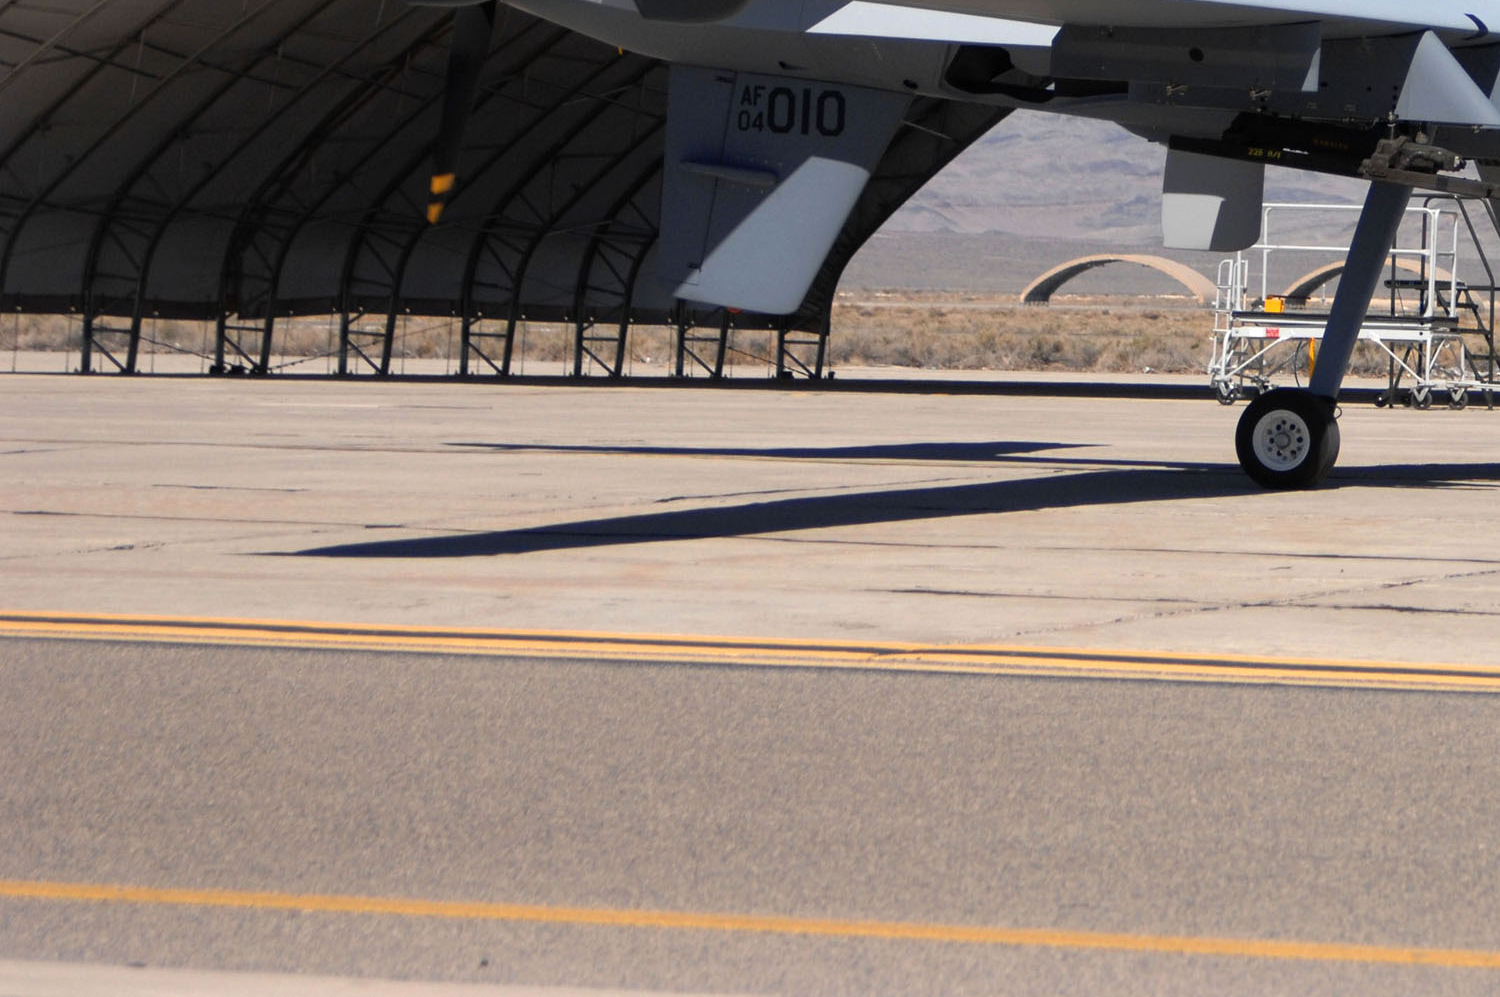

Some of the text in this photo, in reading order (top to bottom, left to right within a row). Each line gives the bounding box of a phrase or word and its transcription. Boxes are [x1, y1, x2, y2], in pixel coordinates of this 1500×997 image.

[741, 85, 766, 106] AF
[738, 110, 764, 132] 04
[767, 87, 846, 136] 010
